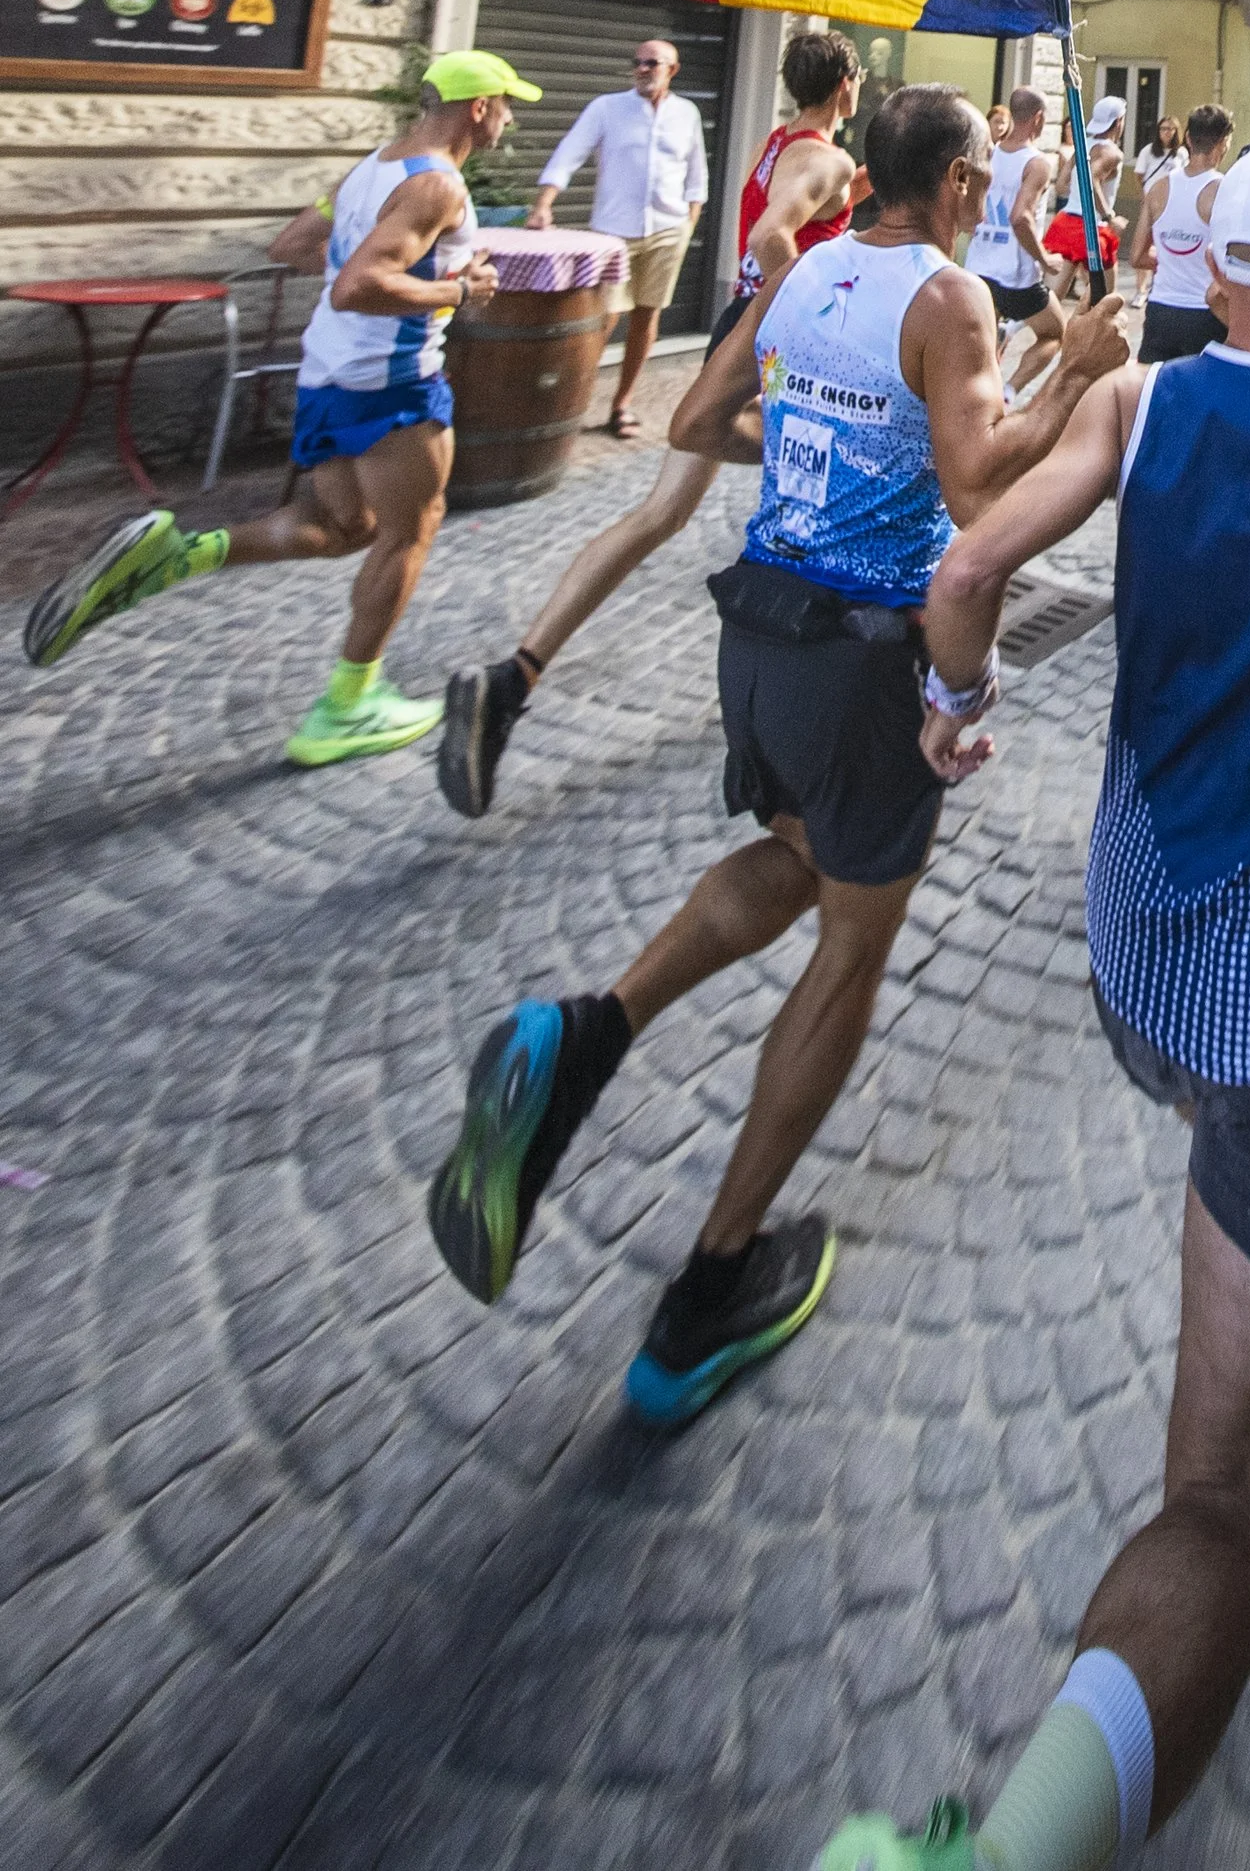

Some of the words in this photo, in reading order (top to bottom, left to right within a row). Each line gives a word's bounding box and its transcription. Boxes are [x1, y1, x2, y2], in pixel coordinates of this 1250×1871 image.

[787, 374, 814, 395] GAS
[820, 385, 887, 412] ENERGY
[782, 437, 827, 476] FACEM
